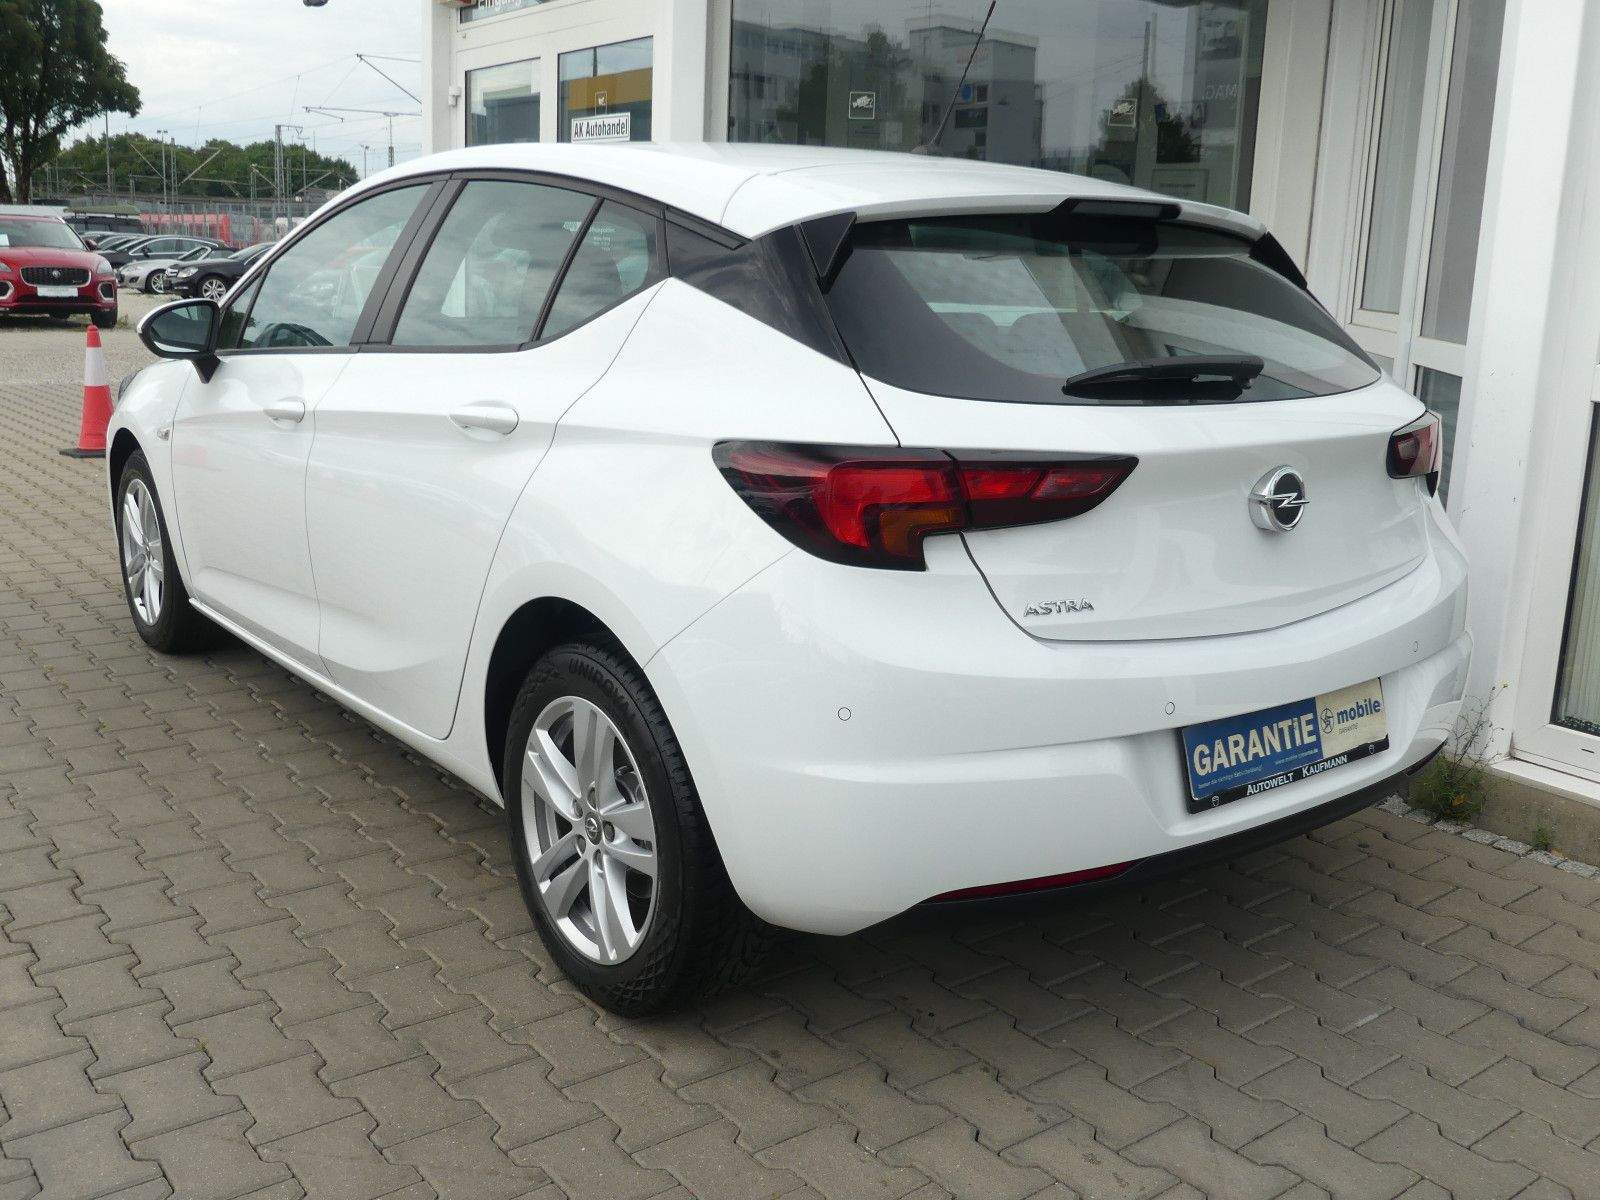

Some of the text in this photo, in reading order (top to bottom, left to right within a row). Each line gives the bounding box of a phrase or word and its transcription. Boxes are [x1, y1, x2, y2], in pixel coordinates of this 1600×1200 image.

[574, 118, 628, 138] AK Autohandel
[1024, 597, 1095, 617] ASTRA
[1336, 698, 1382, 724] mobile
[1302, 755, 1348, 778] KAUFMANN
